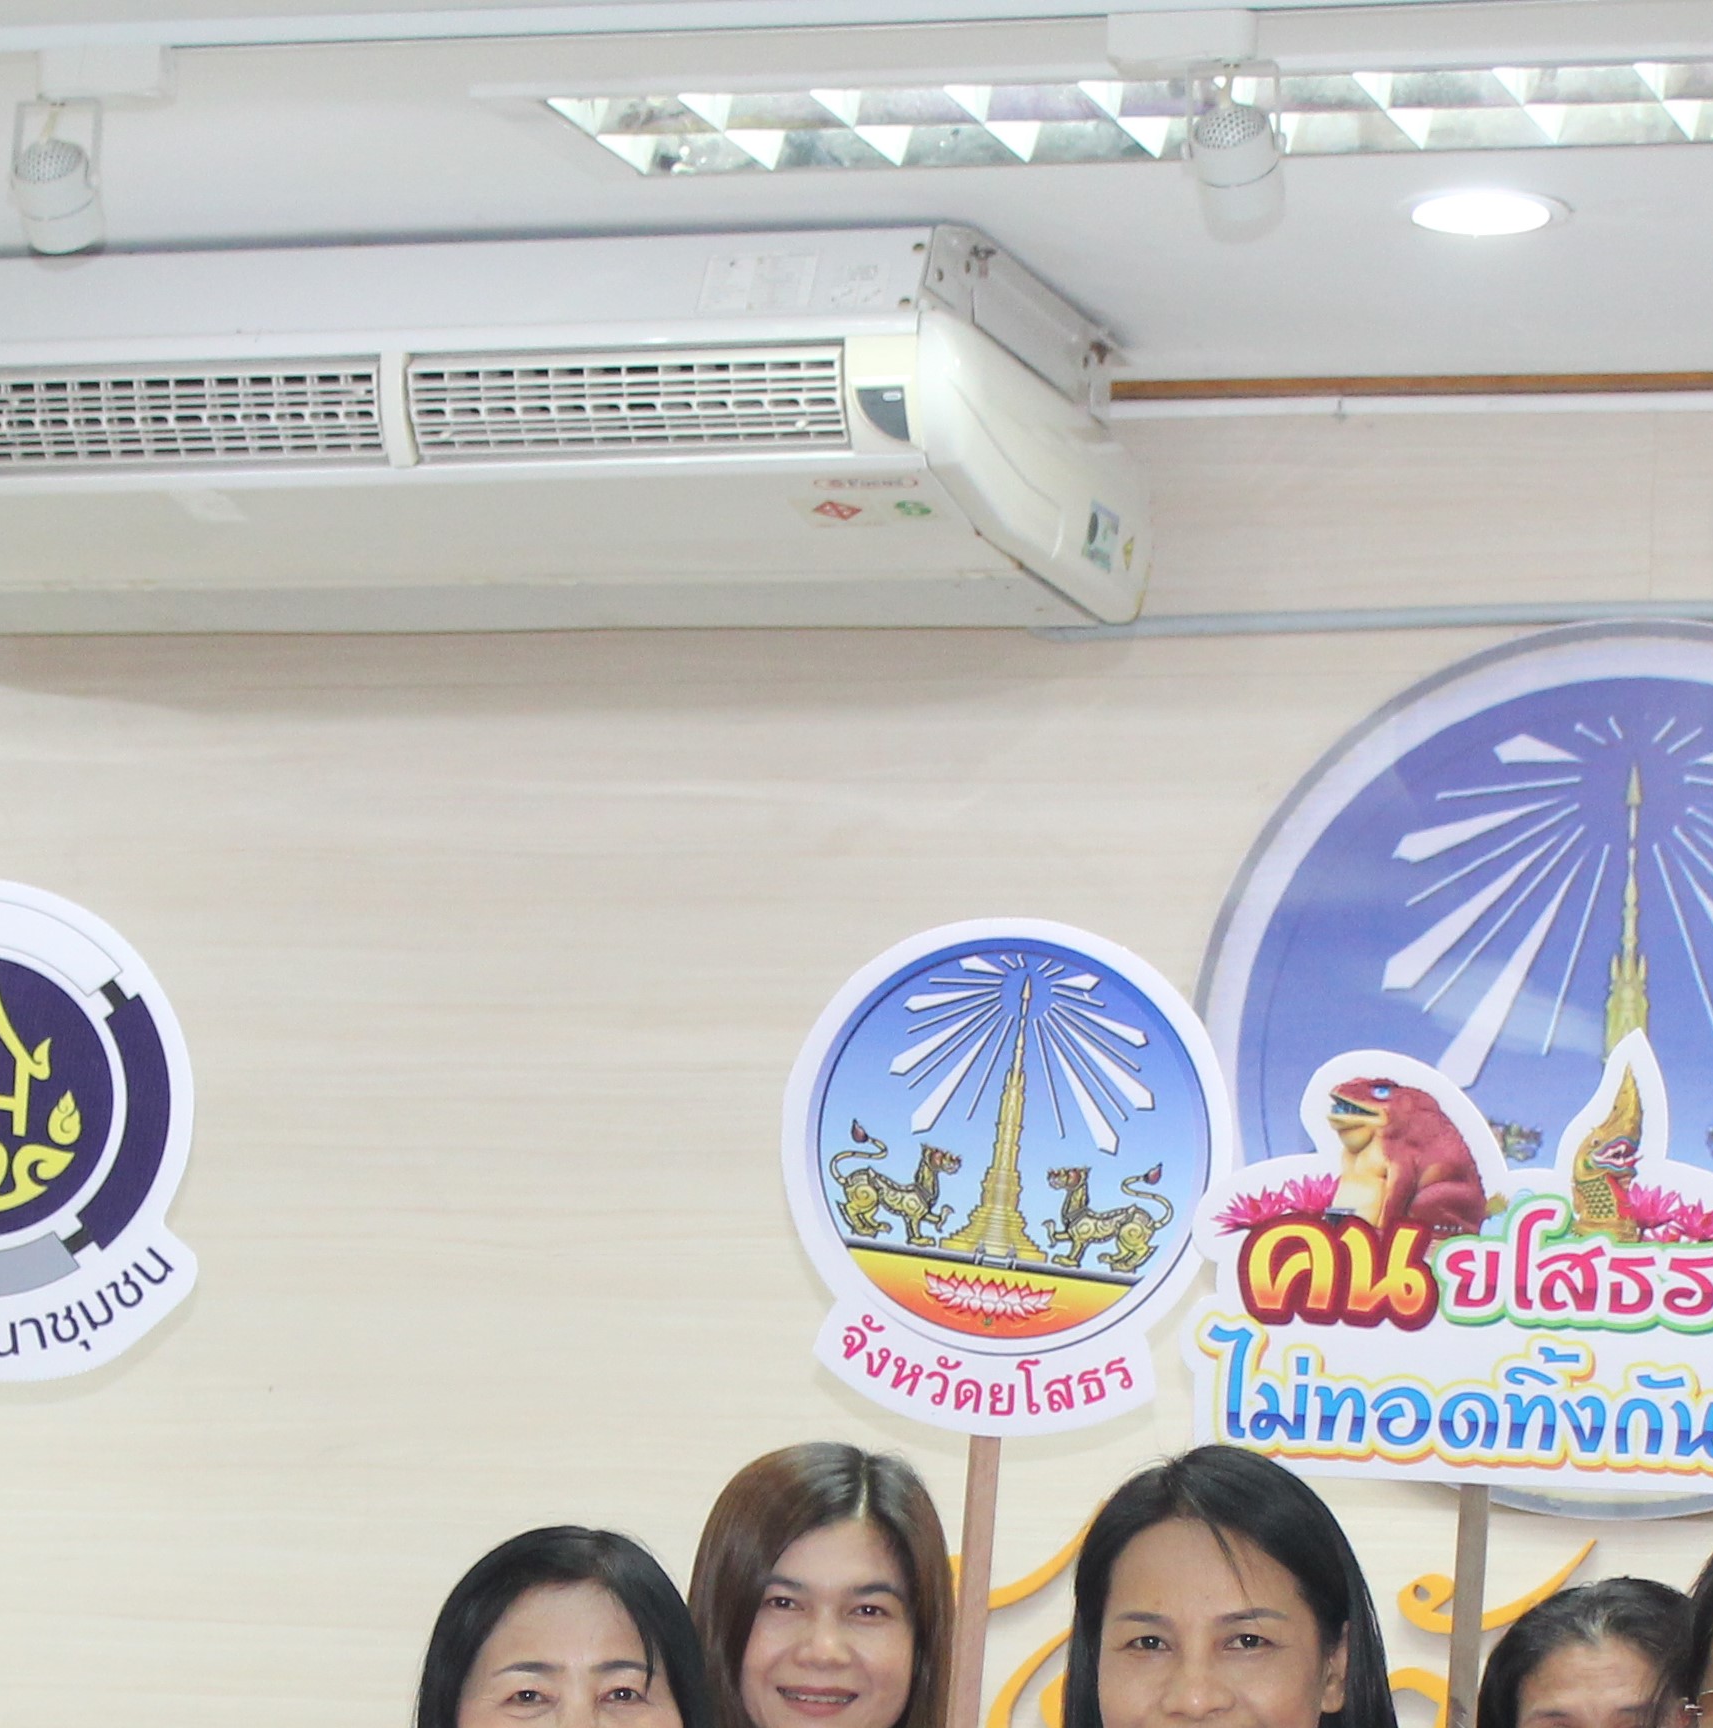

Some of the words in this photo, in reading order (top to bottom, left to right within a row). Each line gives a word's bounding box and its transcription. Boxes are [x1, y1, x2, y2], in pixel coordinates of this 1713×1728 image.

[839, 1315, 1138, 1423] จังหวัดยโสธร
